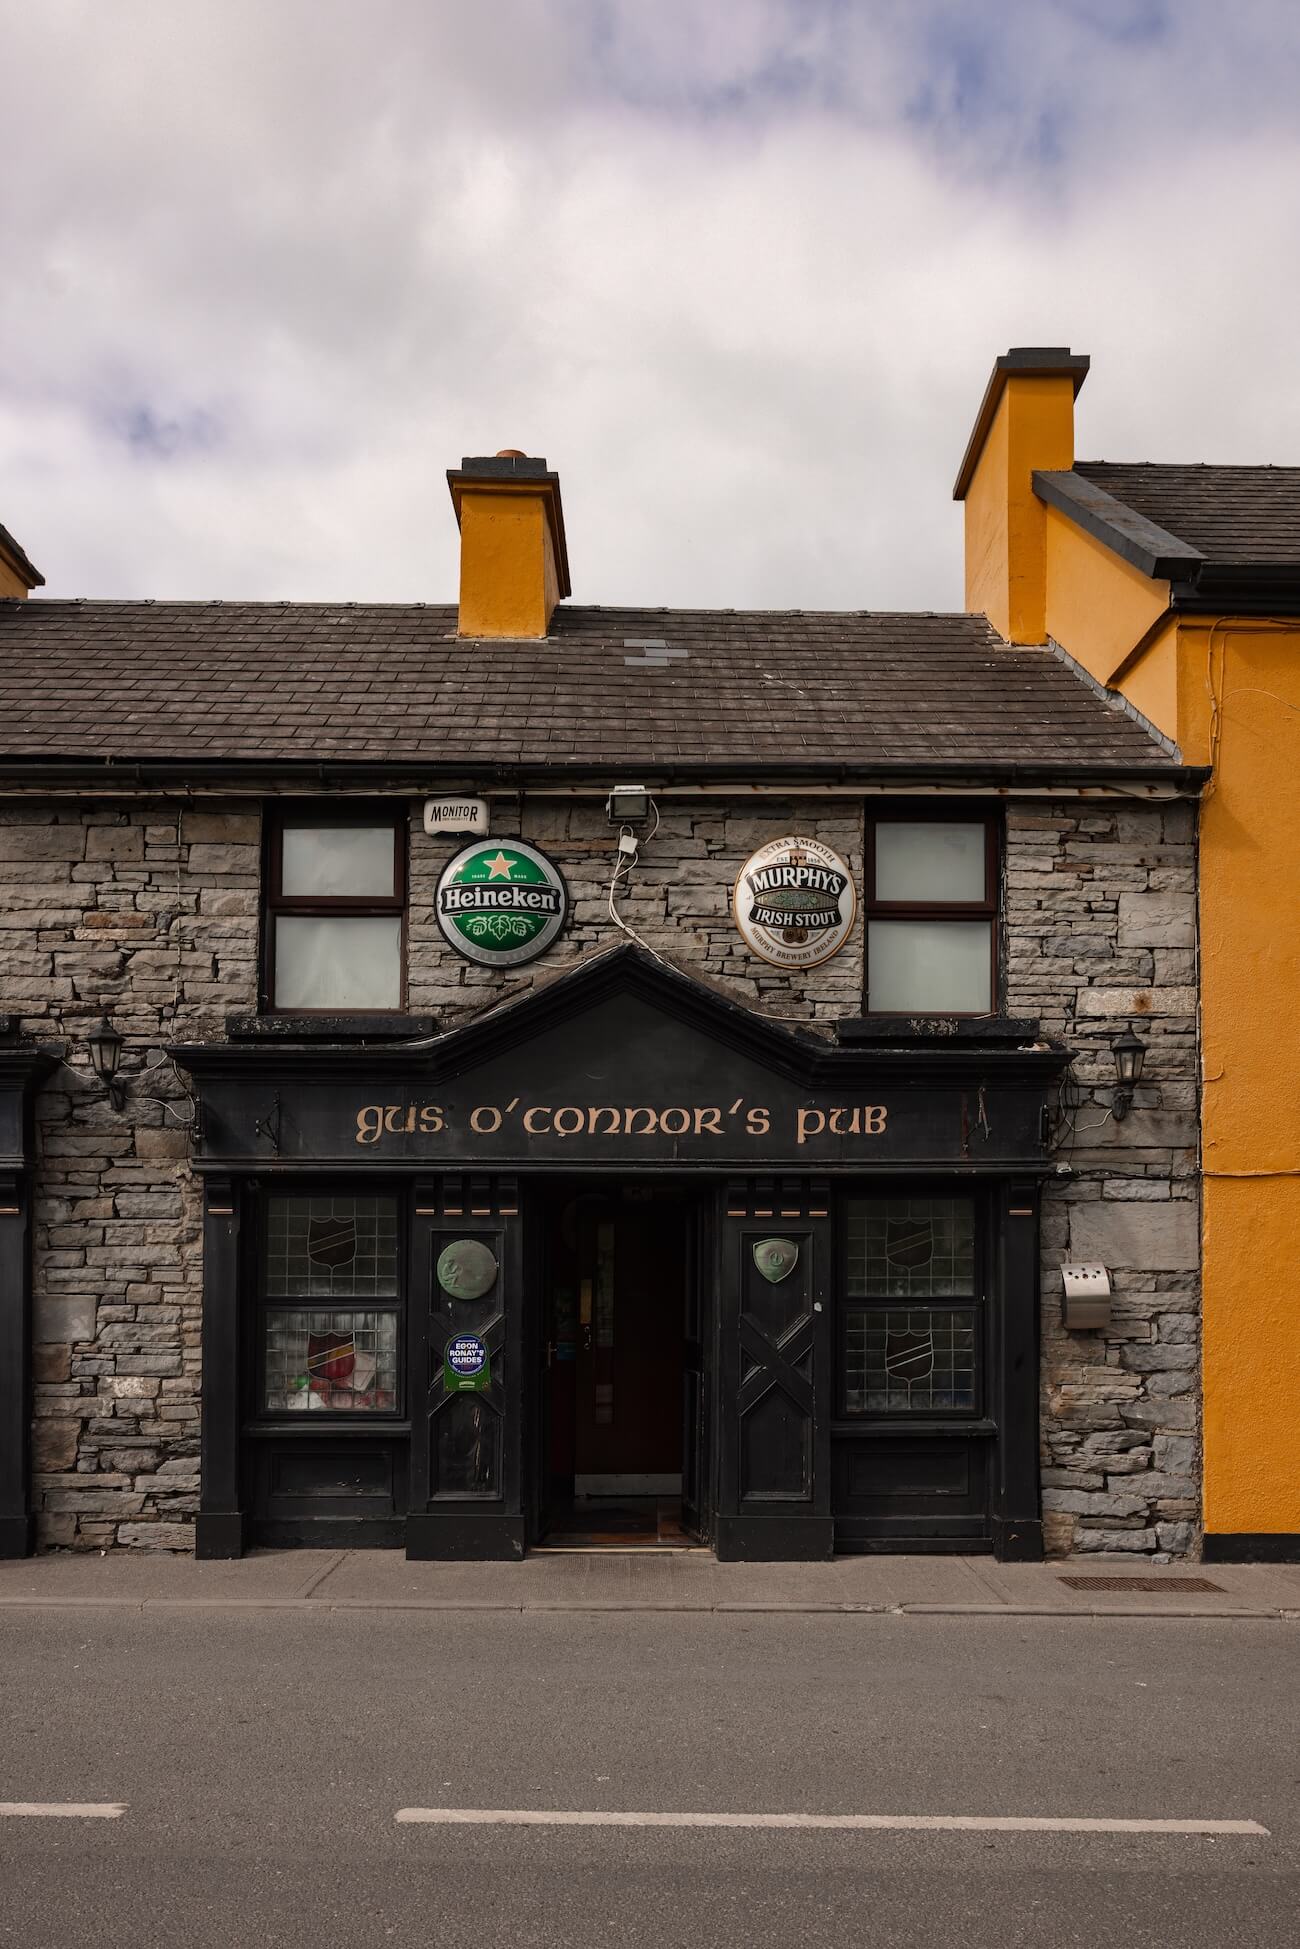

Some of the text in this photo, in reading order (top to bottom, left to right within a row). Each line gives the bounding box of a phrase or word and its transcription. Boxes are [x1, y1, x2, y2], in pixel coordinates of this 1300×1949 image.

[430, 806, 478, 822] MONITOR
[758, 837, 836, 863] EXTRA SMOOTH
[751, 866, 842, 895] MURPHY'S
[444, 887, 557, 911] Heineken
[756, 908, 836, 927] IRISH STOUT
[750, 927, 839, 961] MURPHY BREWERY IRELAND
